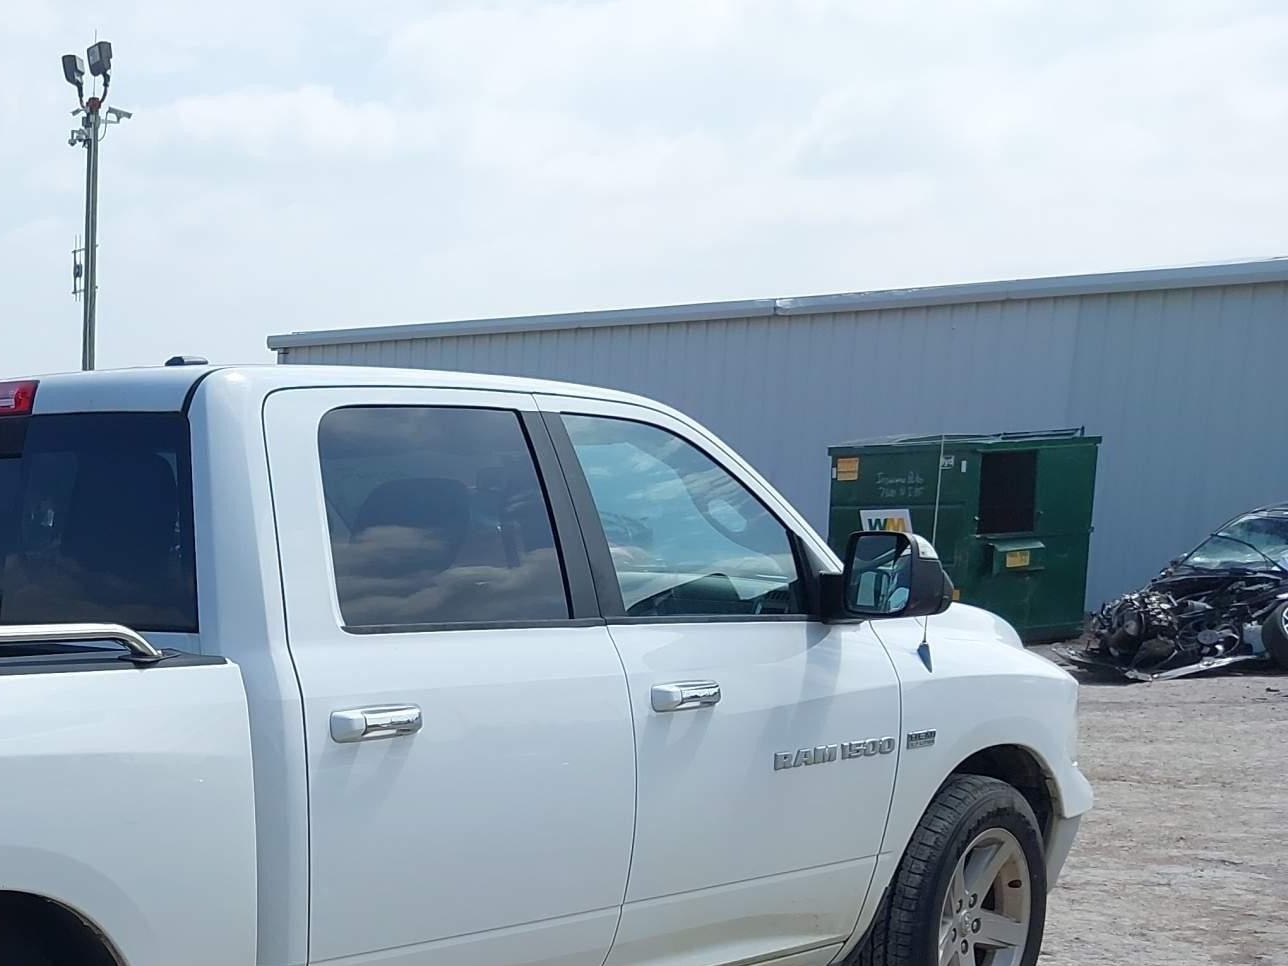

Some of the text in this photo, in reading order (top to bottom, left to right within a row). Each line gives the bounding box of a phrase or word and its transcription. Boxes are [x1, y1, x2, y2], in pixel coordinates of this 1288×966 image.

[866, 517, 907, 531] WM
[774, 736, 895, 771] RAM 1500
